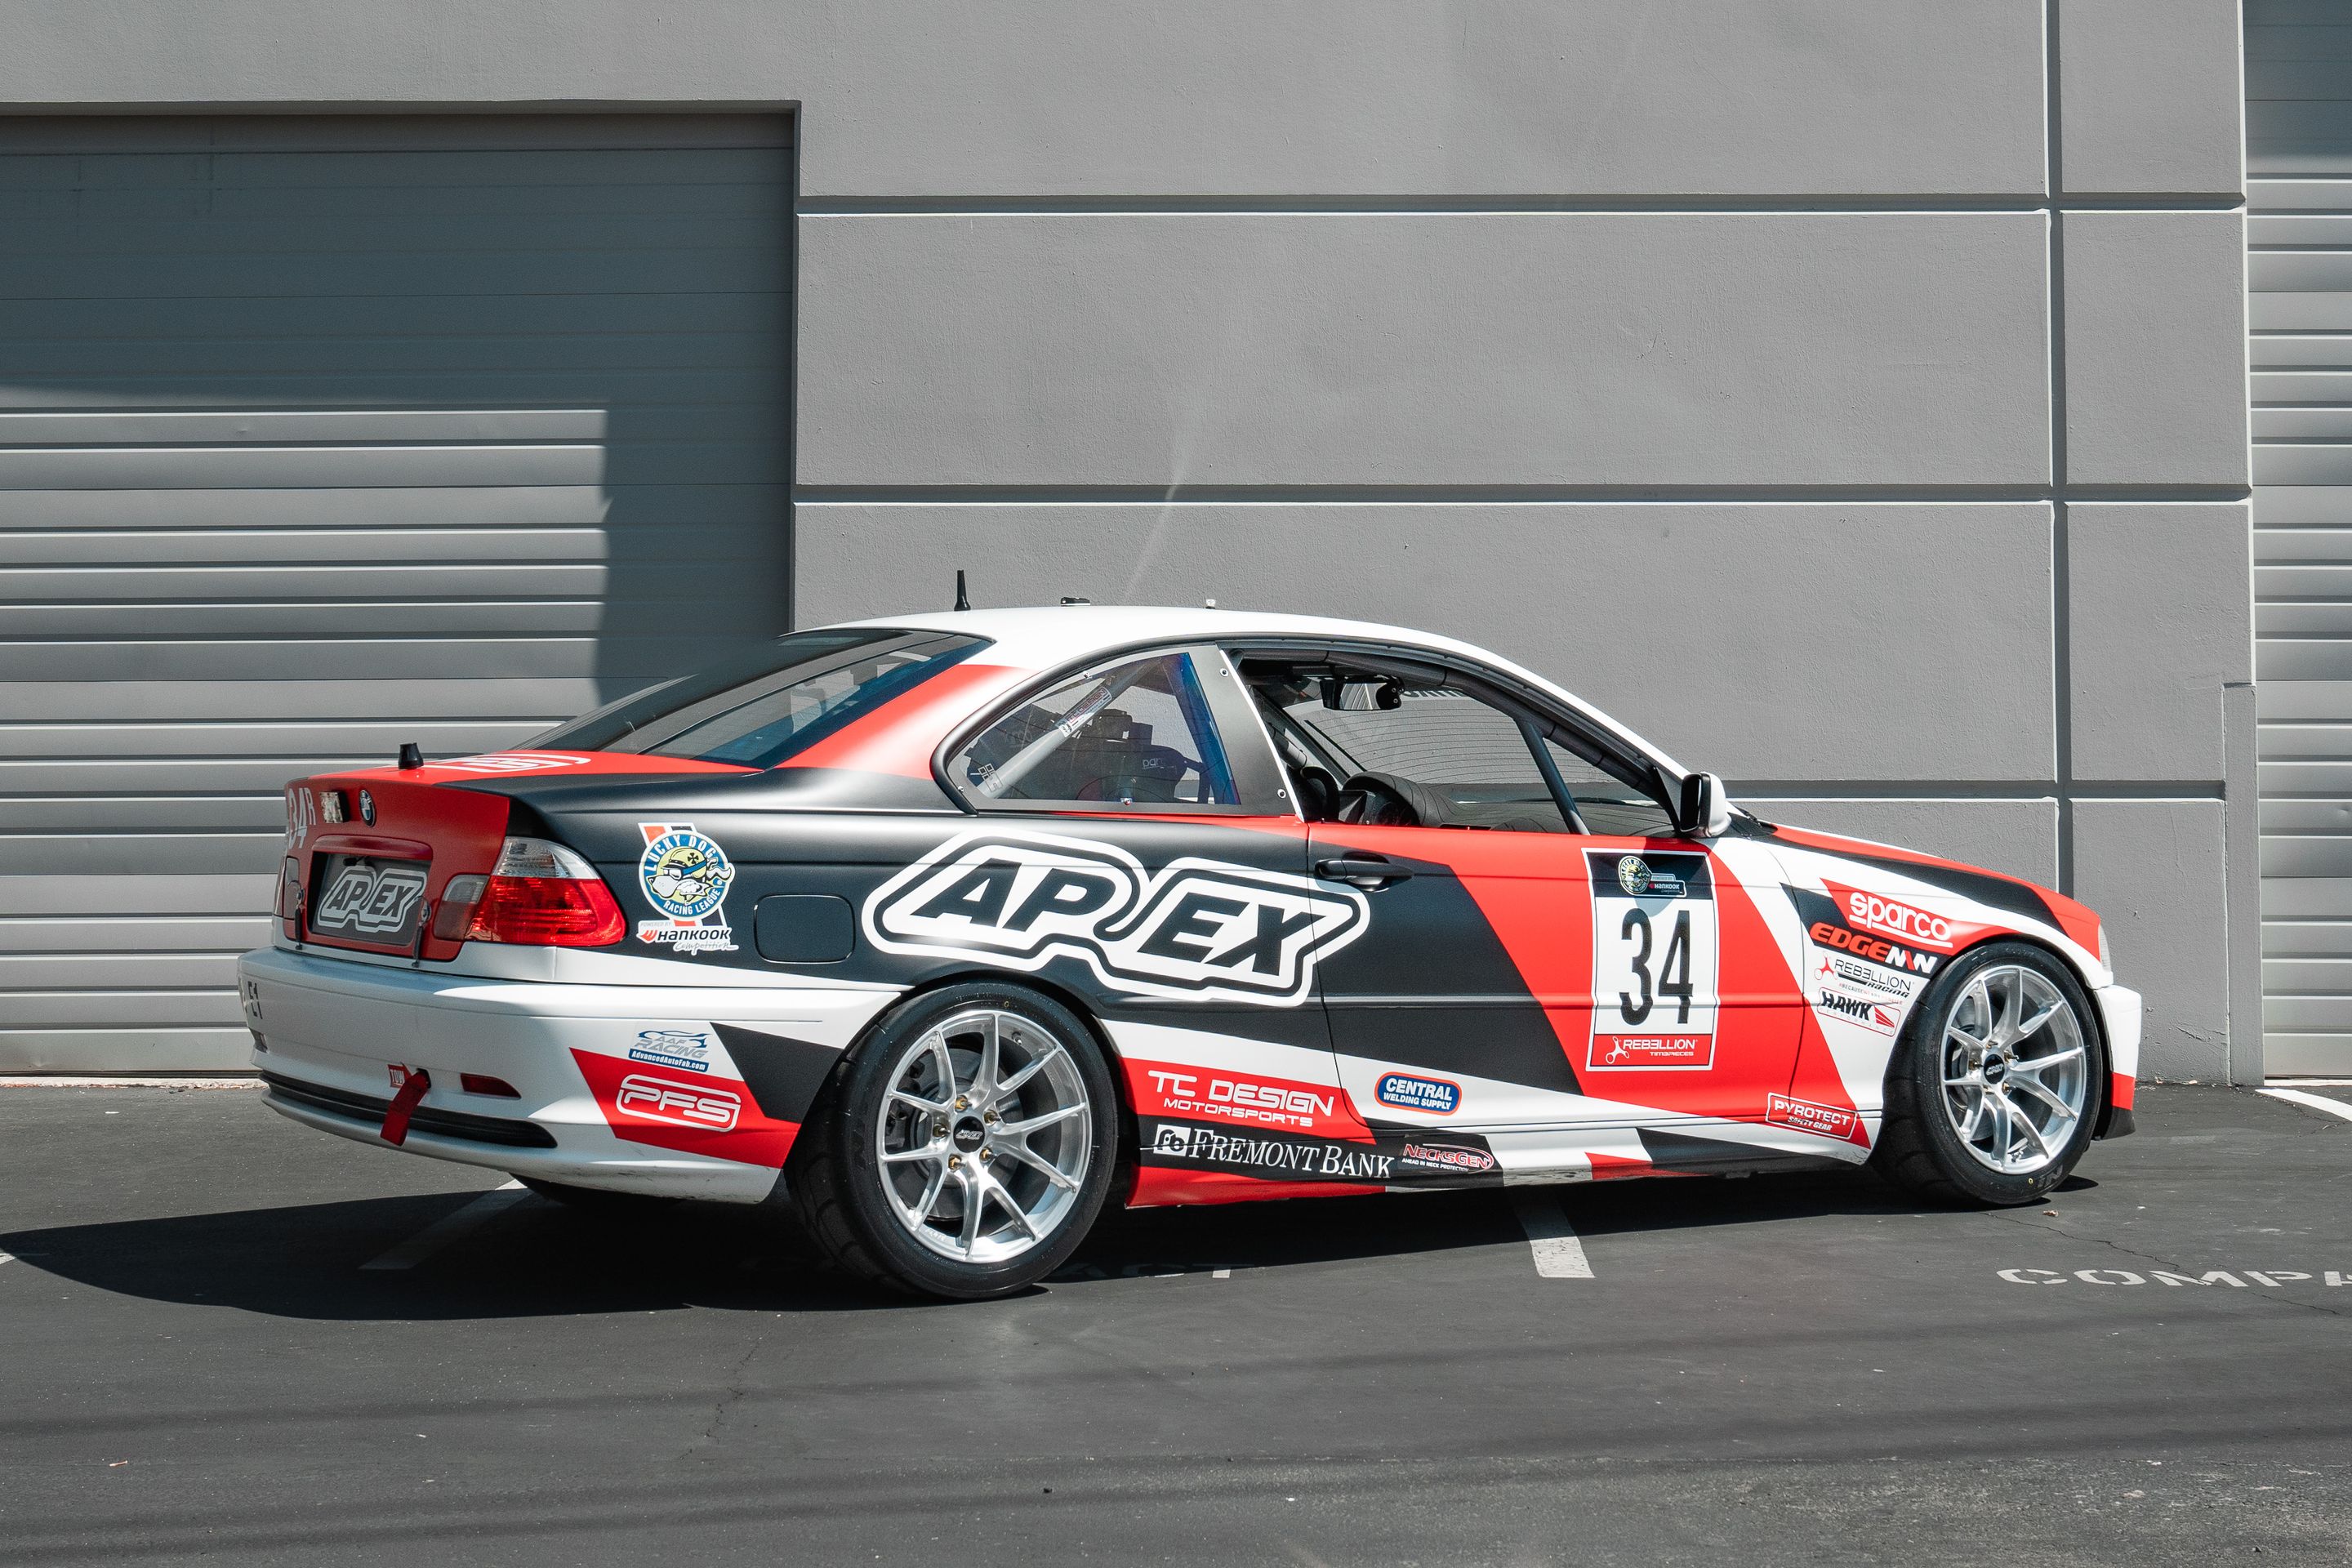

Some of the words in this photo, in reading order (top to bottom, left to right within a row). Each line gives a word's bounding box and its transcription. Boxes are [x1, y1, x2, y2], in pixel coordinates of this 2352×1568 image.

[644, 834, 681, 872] LUCKY
[688, 835, 718, 858] DOG
[324, 876, 416, 920] APEX
[663, 900, 693, 915] RACING
[695, 889, 721, 911] LEAGUE
[909, 856, 1329, 978] APEX
[1849, 891, 1952, 942] sparco
[1619, 907, 1694, 1026] 34
[1820, 991, 1873, 1021] HAWK
[635, 1039, 709, 1059] RACING
[655, 1036, 687, 1045] AAF
[631, 1050, 706, 1071] AdvancedAutoFab.com
[621, 1084, 739, 1123] PFS
[1147, 1070, 1197, 1098] TC
[1208, 1079, 1334, 1117] DESIGN
[1383, 1092, 1419, 1105] WELDING
[1421, 1098, 1452, 1110] SUPPLY
[1385, 1078, 1453, 1102] CENTRAL
[1164, 1098, 1313, 1128] MOTORSPORTS
[1774, 1099, 1851, 1126] PYROTECT
[1813, 1120, 1833, 1131] GEAR
[1401, 1157, 1419, 1165] AHEAD
